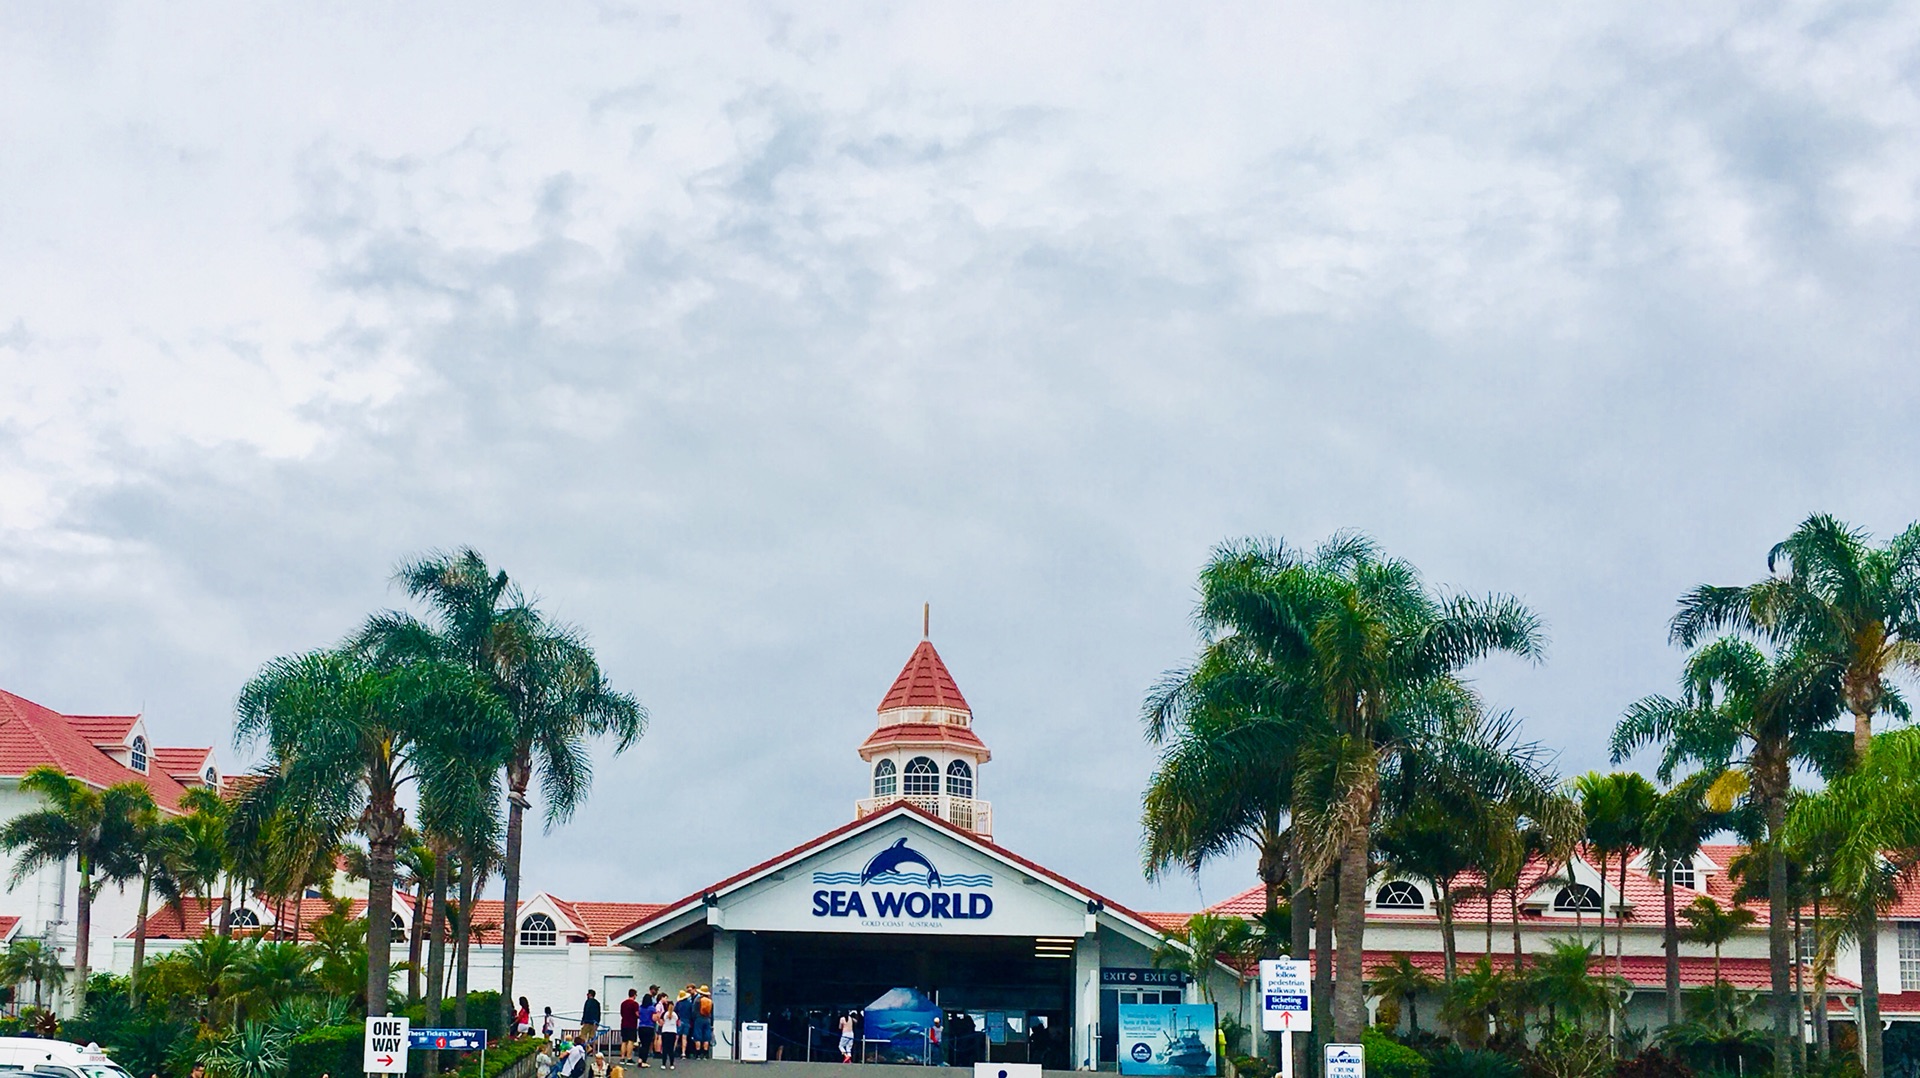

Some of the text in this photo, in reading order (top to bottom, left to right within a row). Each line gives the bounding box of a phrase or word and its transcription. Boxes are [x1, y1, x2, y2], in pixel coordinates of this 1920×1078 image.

[812, 890, 993, 919] SEA WORLD
[882, 920, 904, 928] COAST
[908, 921, 943, 929] AUSTRALIA
[1103, 972, 1167, 982] EXIT EXIT
[1268, 979, 1305, 987] pedestrian
[1267, 987, 1296, 995] walkway
[1271, 996, 1302, 1004] ticketing
[373, 1021, 402, 1036] ONE
[462, 1030, 476, 1038] Way
[372, 1038, 401, 1053] WAY
[438, 1038, 444, 1047] 1
